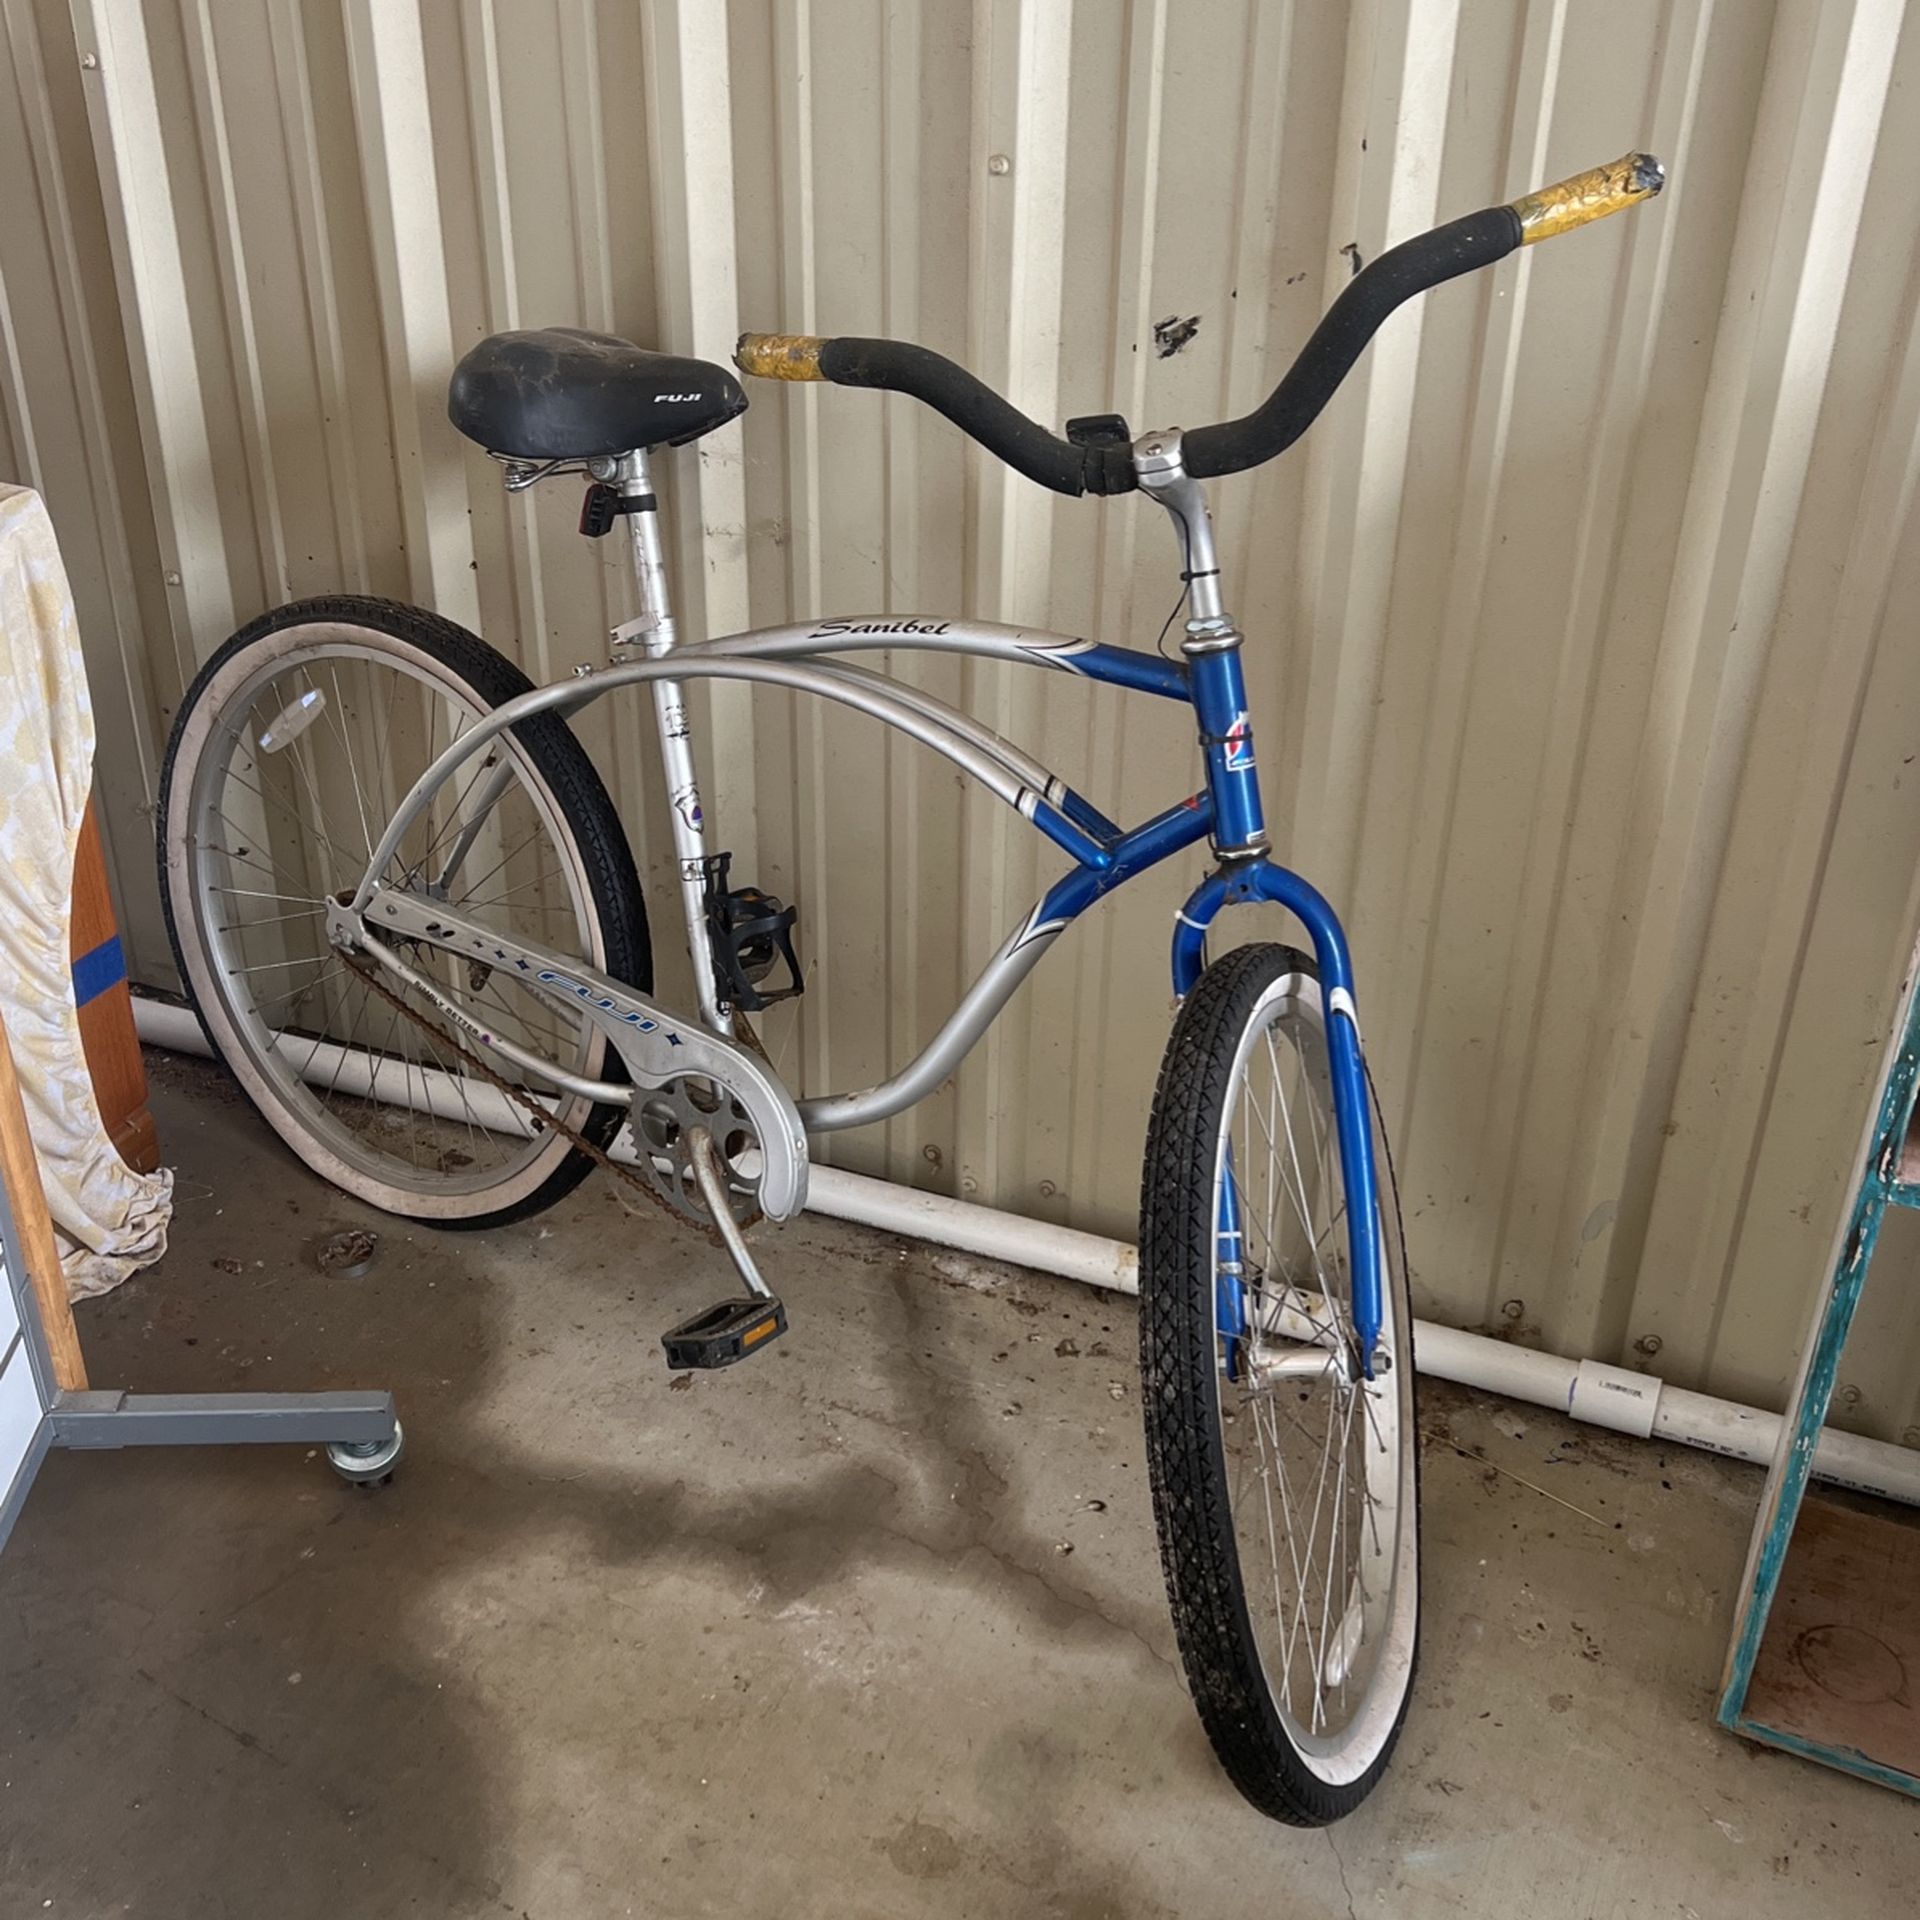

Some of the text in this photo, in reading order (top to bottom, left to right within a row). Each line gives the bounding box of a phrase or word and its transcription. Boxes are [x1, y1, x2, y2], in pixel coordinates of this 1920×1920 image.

[653, 393, 702, 402] FUJI
[807, 619, 951, 639] Sanibel
[537, 970, 659, 1033] FUJI
[445, 1007, 479, 1036] BETTER
